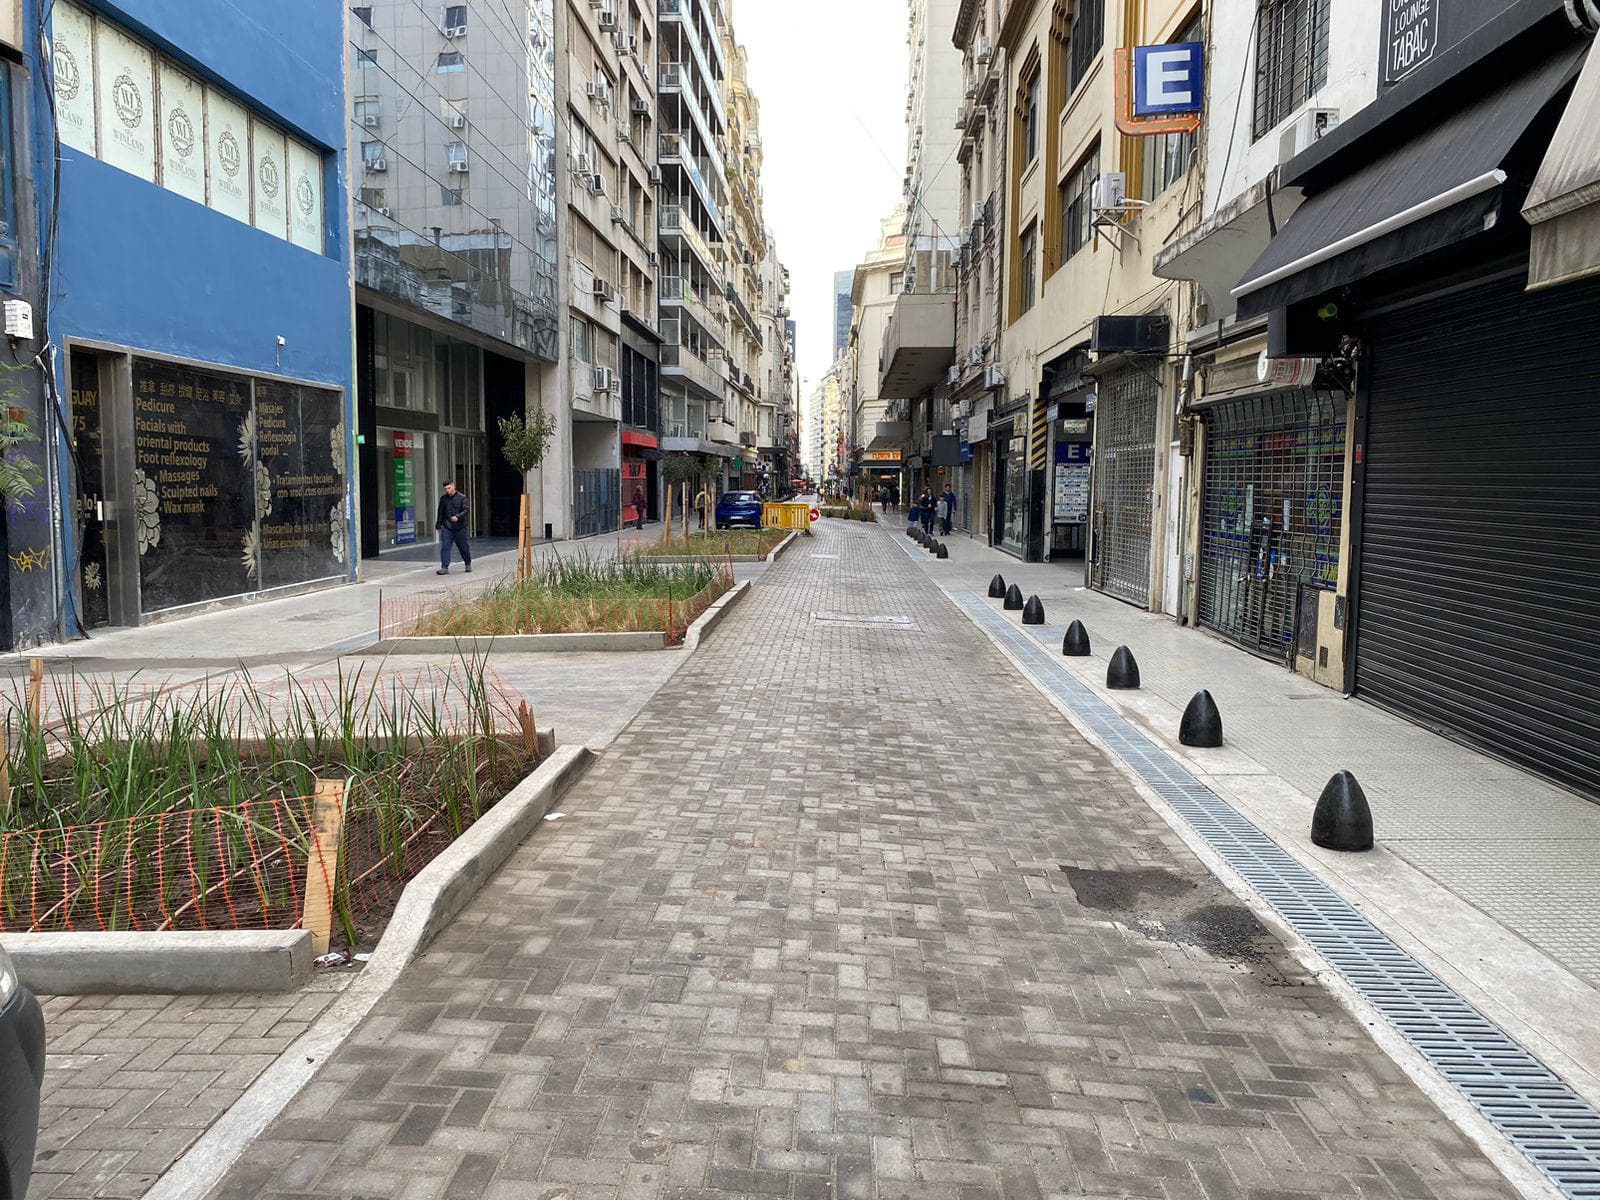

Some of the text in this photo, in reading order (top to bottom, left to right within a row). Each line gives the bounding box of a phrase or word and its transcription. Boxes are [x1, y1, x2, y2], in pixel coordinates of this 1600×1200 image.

[1395, 0, 1430, 35] LOUNGE
[1392, 18, 1428, 70] TABAC
[1147, 50, 1192, 106] E
[57, 106, 83, 126] NLAND
[113, 128, 145, 152] WINLAND
[170, 159, 197, 178] WINLAND
[219, 178, 242, 196] WINLAND
[136, 396, 175, 413] Pedicure
[259, 402, 284, 416] Masajes
[136, 416, 186, 435] Facials with
[259, 416, 286, 429] Pedicura
[137, 434, 210, 453] oriental products
[261, 445, 279, 458] podal
[394, 438, 413, 449] VENDE
[1068, 444, 1079, 458] E
[138, 450, 208, 469] Foot reflexology
[160, 469, 200, 484] Massages
[162, 484, 218, 501] Sculpted nails
[163, 500, 205, 514] Wax mask
